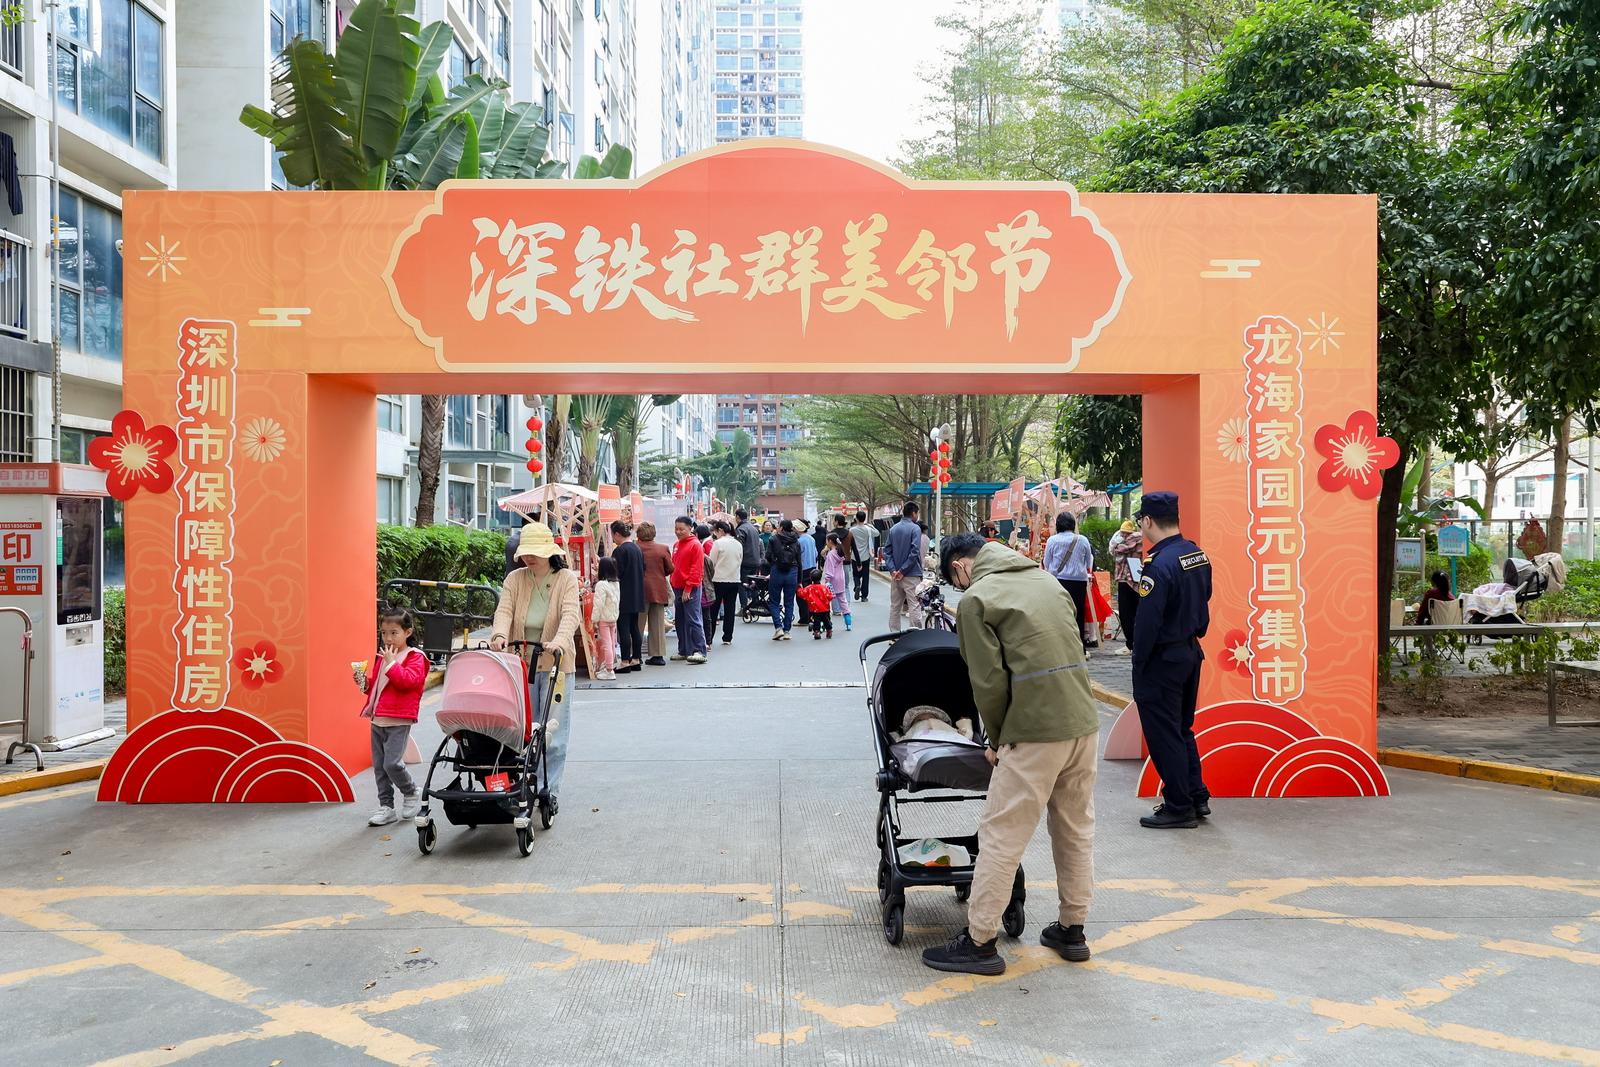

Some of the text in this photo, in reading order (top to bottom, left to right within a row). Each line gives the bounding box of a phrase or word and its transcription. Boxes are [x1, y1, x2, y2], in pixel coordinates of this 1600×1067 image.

[467, 209, 1053, 342] 深铁社群美邻节
[180, 326, 229, 705] 深圳市保障性住房
[1252, 323, 1298, 698] 龙海家园元旦集市
